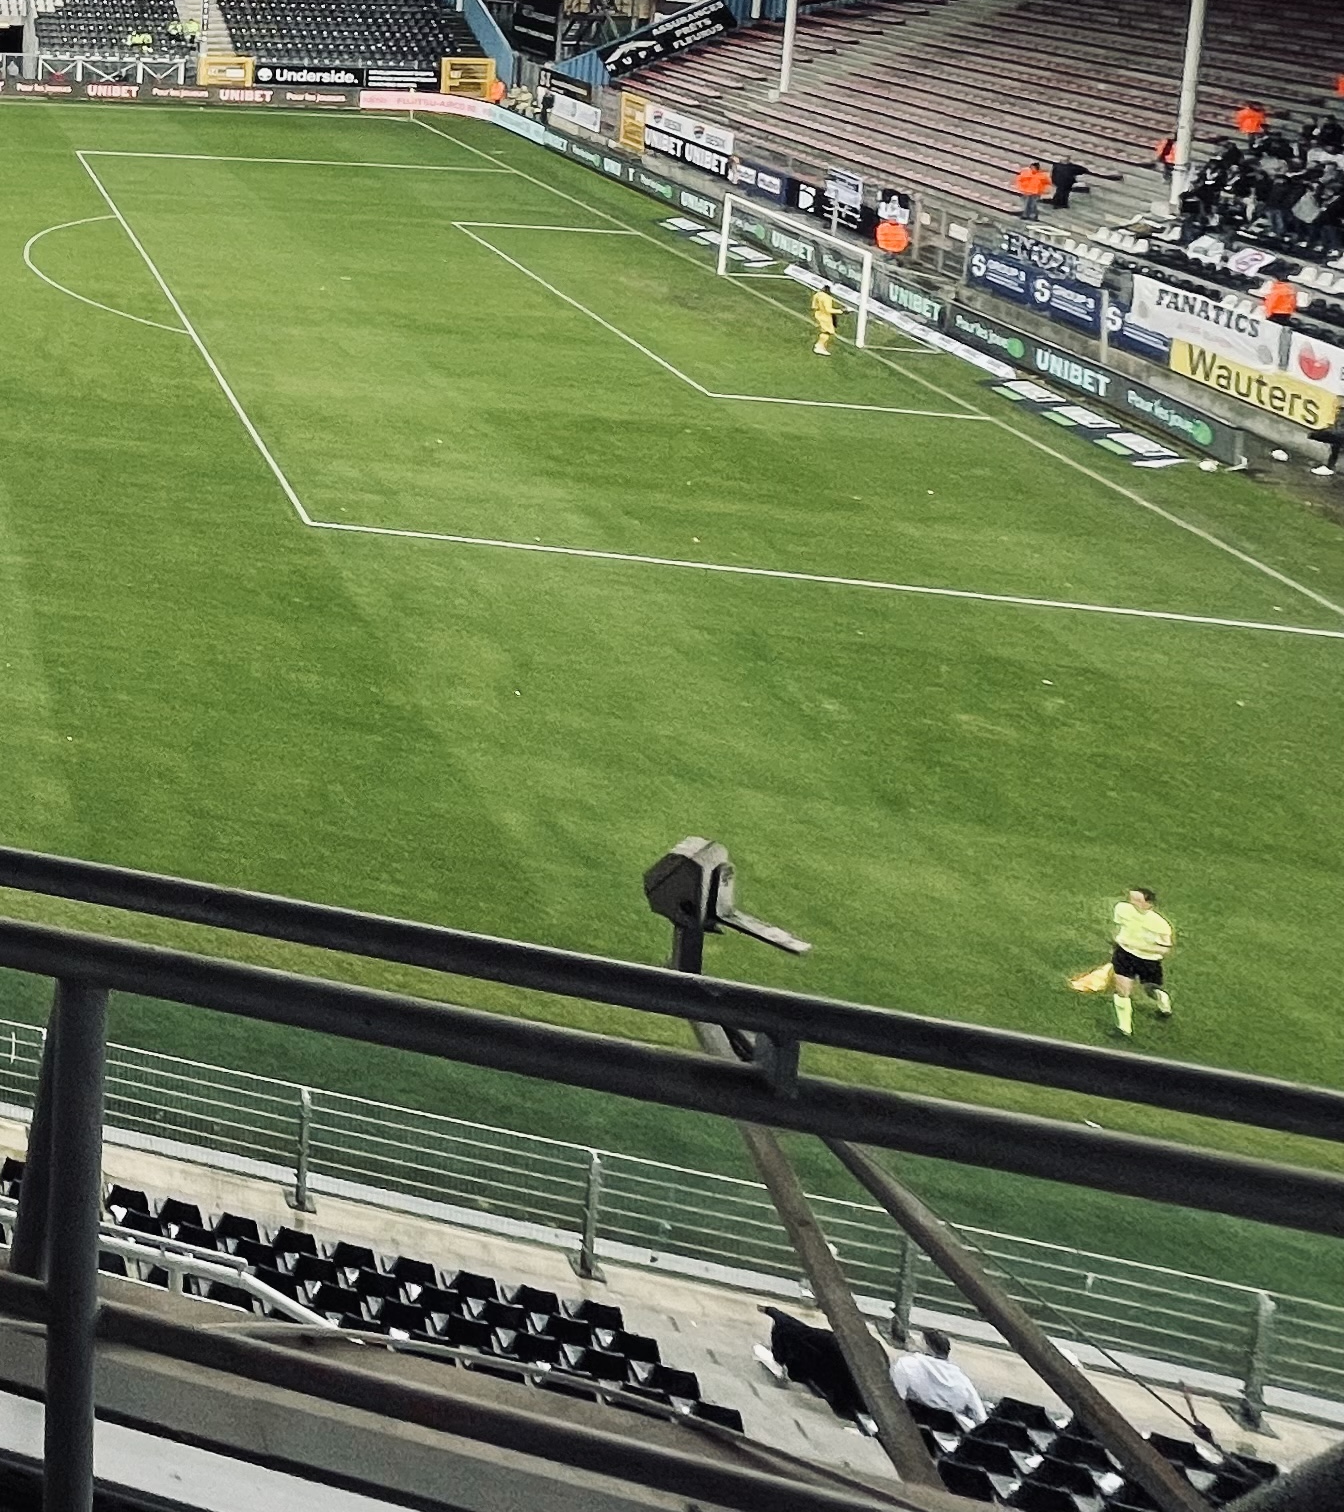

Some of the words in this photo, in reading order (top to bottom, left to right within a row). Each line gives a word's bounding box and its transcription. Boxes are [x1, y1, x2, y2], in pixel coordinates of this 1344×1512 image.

[651, 0, 724, 36] ASSURANCES
[673, 23, 724, 50] FLEURUS
[87, 84, 140, 98] UNIBET
[275, 68, 360, 85] Underside.
[219, 88, 274, 103] UNIBET
[645, 128, 684, 158] UNIBET
[685, 143, 729, 176] UNIBET
[771, 231, 815, 262] UNIBET
[889, 284, 943, 321] UNIBET
[1156, 289, 1261, 338] FANATICS
[1035, 348, 1111, 397] UNIBET
[1188, 344, 1321, 426] Wauters
